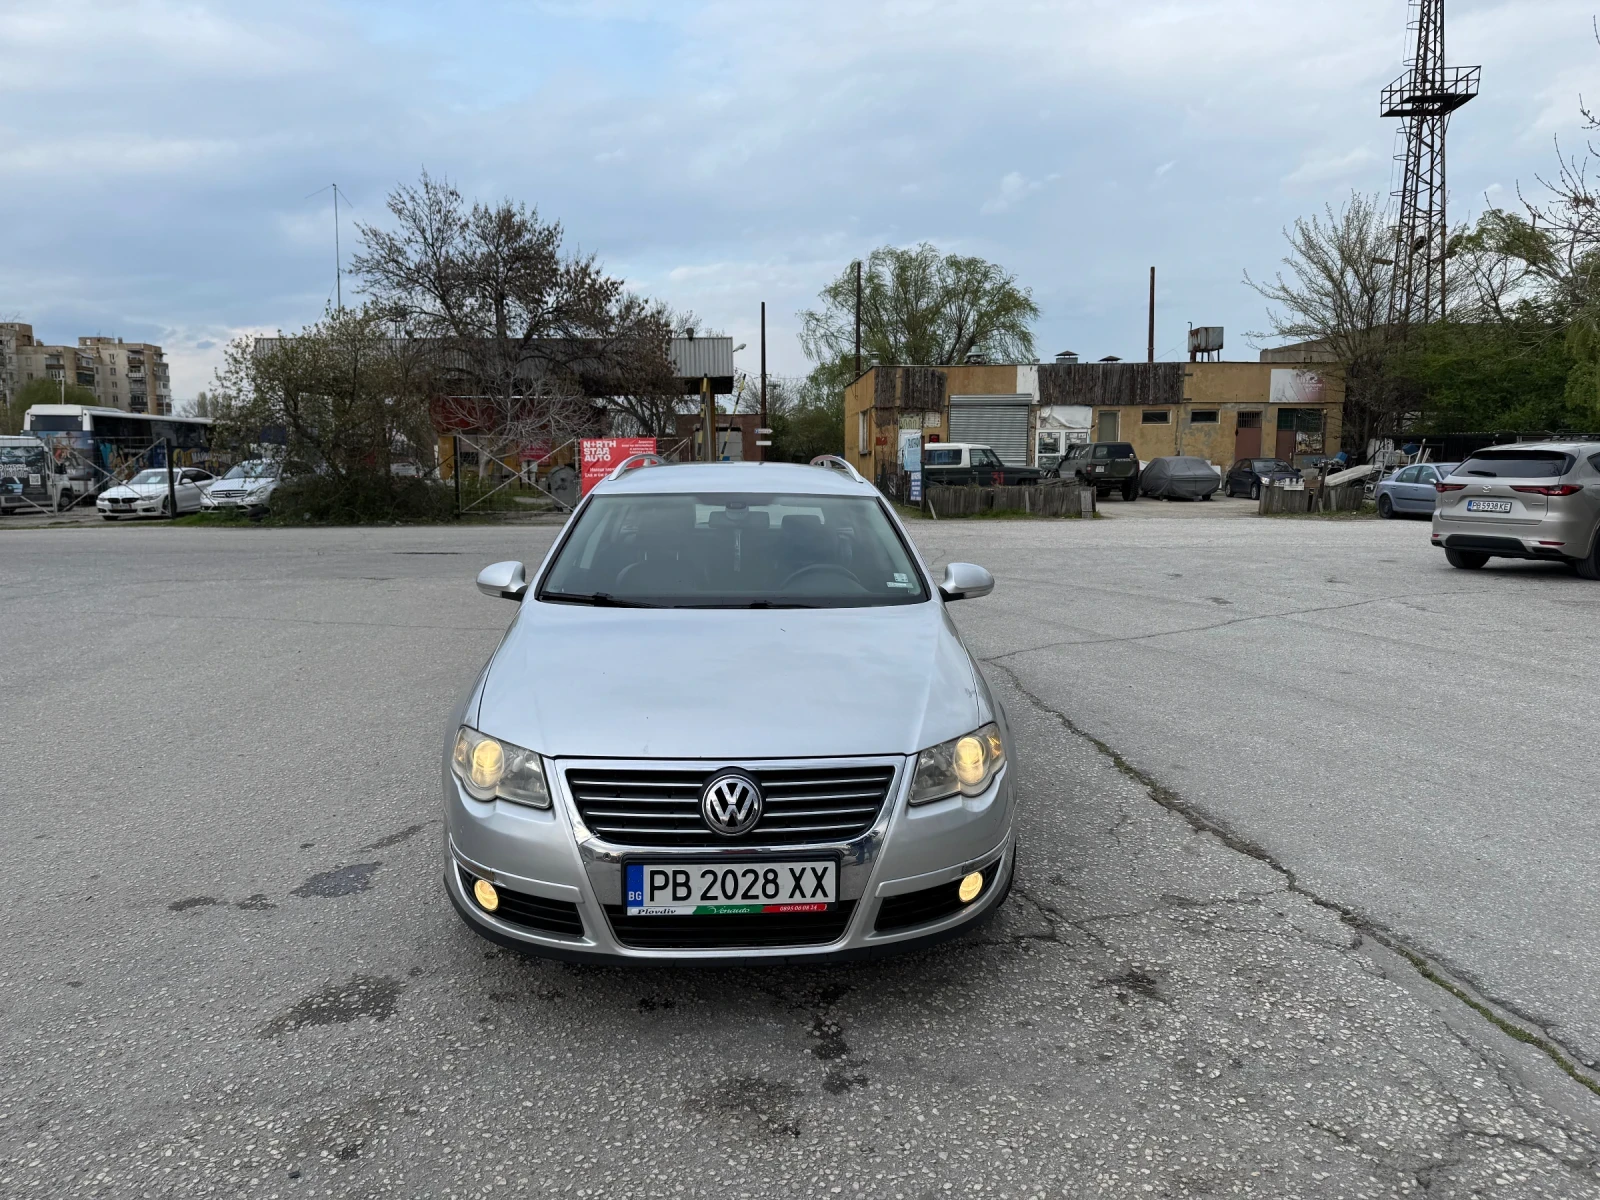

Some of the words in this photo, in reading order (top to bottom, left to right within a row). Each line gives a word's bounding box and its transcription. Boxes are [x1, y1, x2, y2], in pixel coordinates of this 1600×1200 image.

[584, 447, 610, 455] STAR
[584, 454, 611, 462] AUTO
[1472, 501, 1481, 510] PB
[1481, 502, 1499, 510] 5938
[1499, 503, 1510, 511] KE
[649, 869, 692, 902] PB
[700, 868, 780, 901] 2028
[788, 866, 829, 899] XX
[628, 891, 642, 901] BG
[637, 907, 677, 915] Plovdiv
